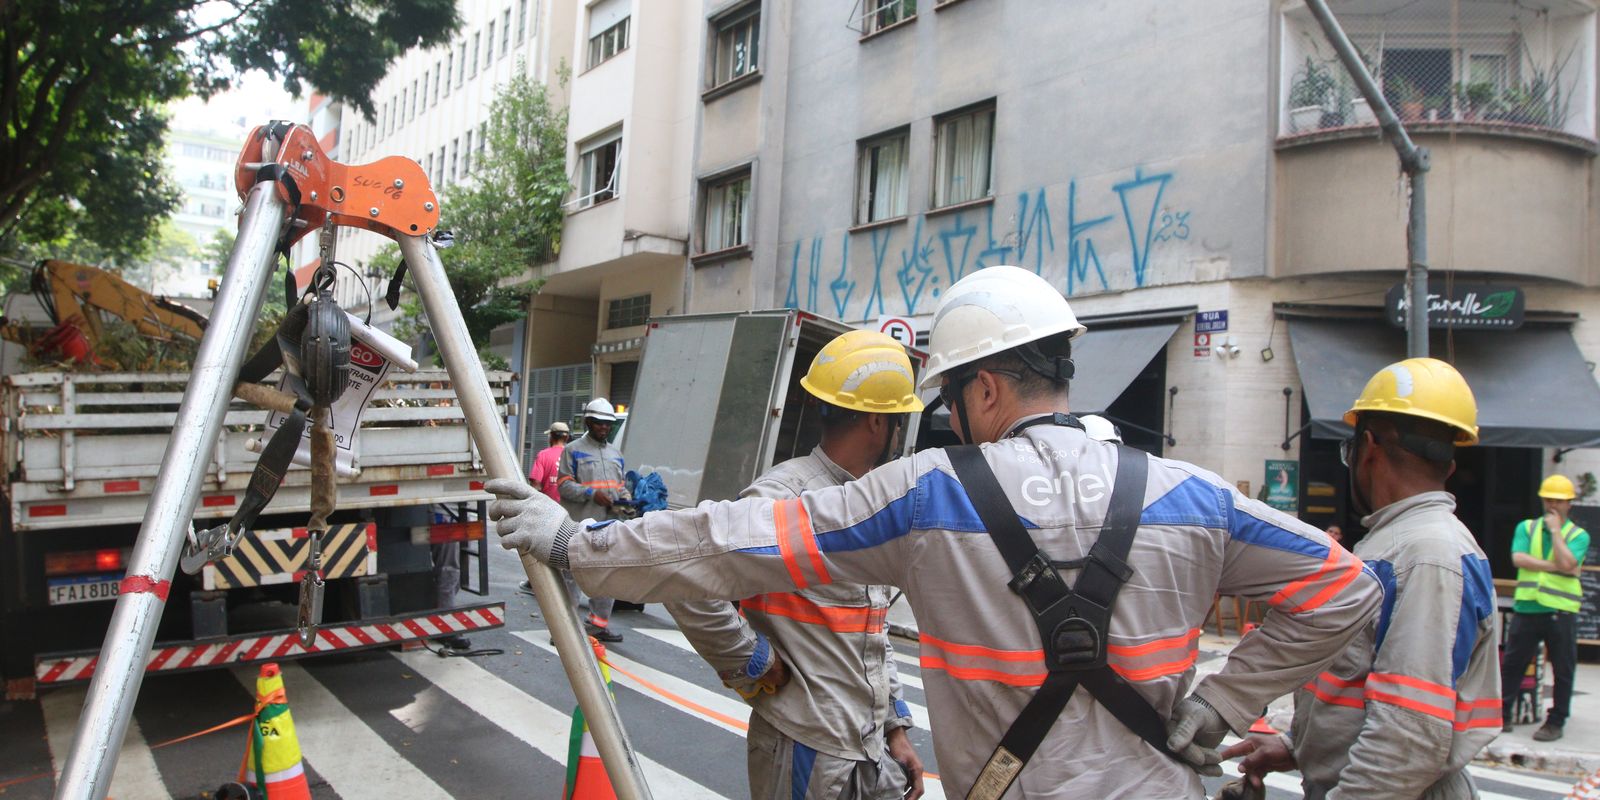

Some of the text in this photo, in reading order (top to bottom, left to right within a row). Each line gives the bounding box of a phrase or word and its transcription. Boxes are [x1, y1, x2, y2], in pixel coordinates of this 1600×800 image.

[1153, 211, 1191, 242] 23
[1202, 311, 1220, 321] RUA
[350, 345, 373, 363] GO
[349, 368, 374, 383] TRADA
[1021, 463, 1116, 506] enel
[56, 582, 120, 602] FAI8D8
[260, 726, 280, 737] GA
